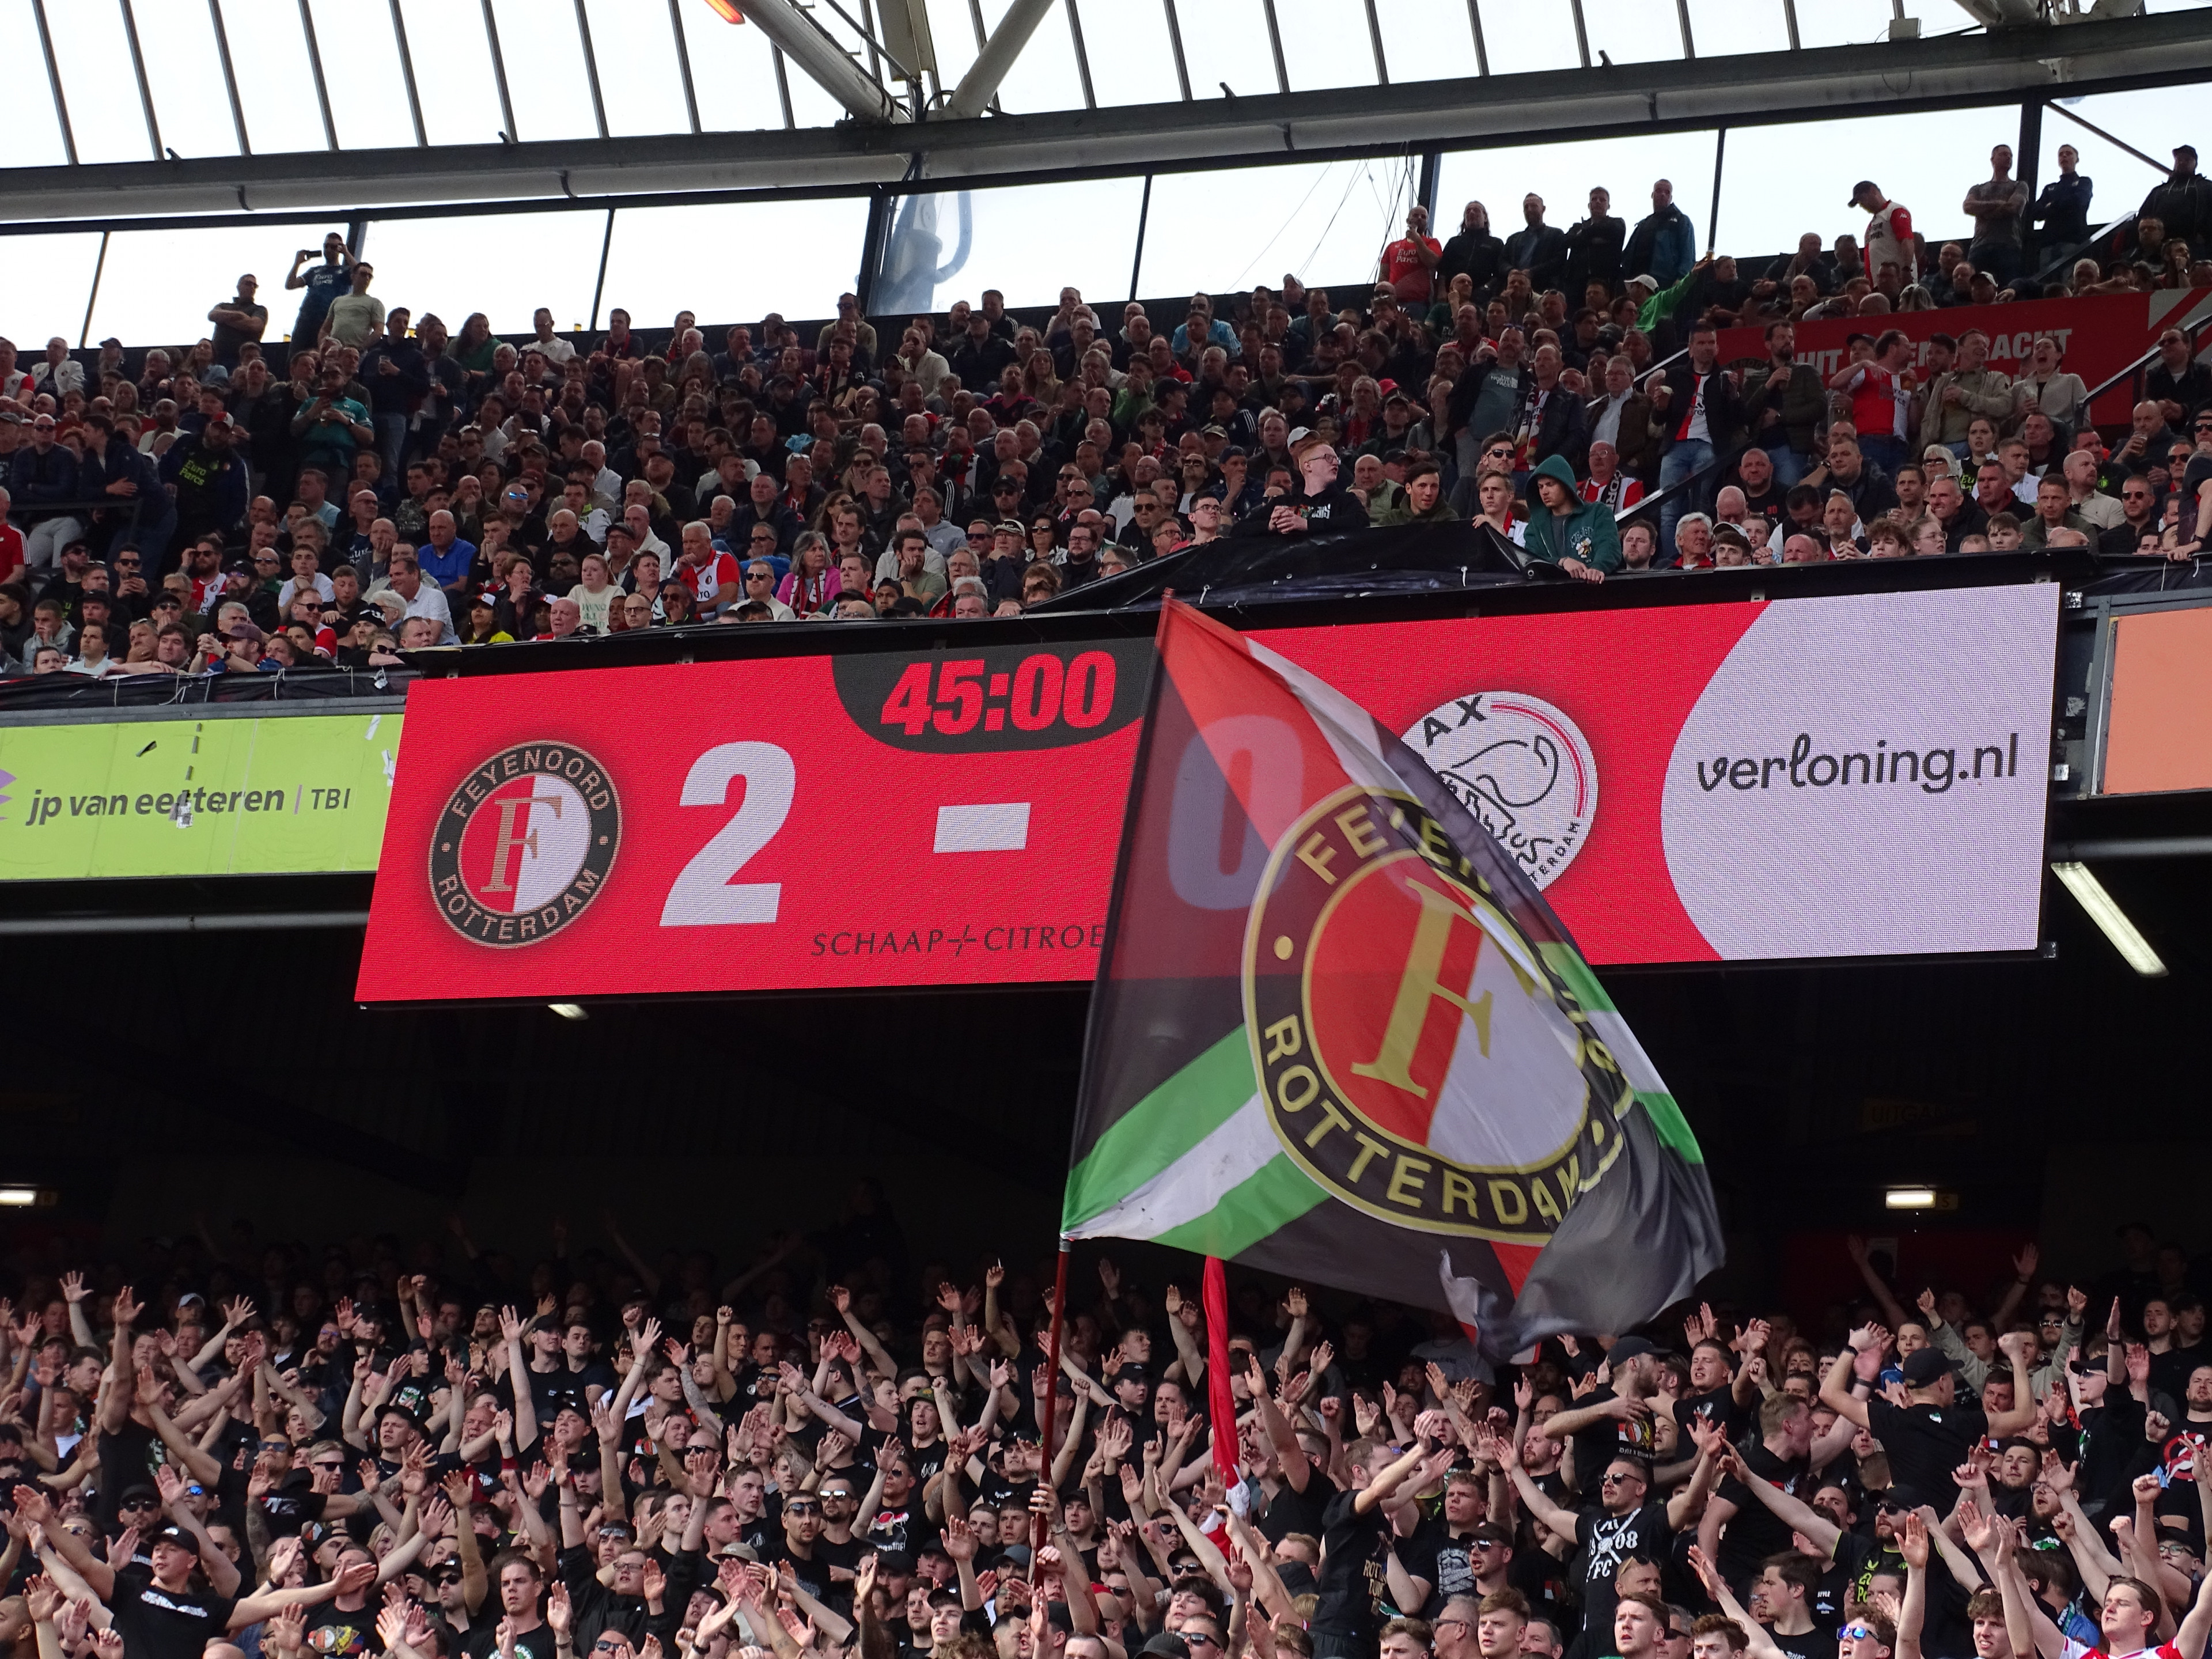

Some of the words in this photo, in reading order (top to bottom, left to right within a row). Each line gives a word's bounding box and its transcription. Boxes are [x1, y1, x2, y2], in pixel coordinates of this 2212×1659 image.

[184, 460, 207, 476] Euro
[880, 650, 1116, 735] 45:00
[1420, 693, 1488, 748] AX
[451, 748, 611, 818] FEYENOORD
[1696, 732, 2019, 794] verloning.nl
[26, 789, 63, 826] jp
[69, 794, 129, 816] van
[310, 787, 351, 810] TBI
[659, 740, 796, 927] 2
[438, 869, 600, 940] ROTTERDAM
[810, 927, 945, 956] SCHAAP
[983, 923, 1105, 952] CITROE
[1614, 1530, 1639, 1550] 08
[1592, 1558, 1613, 1580] FC
